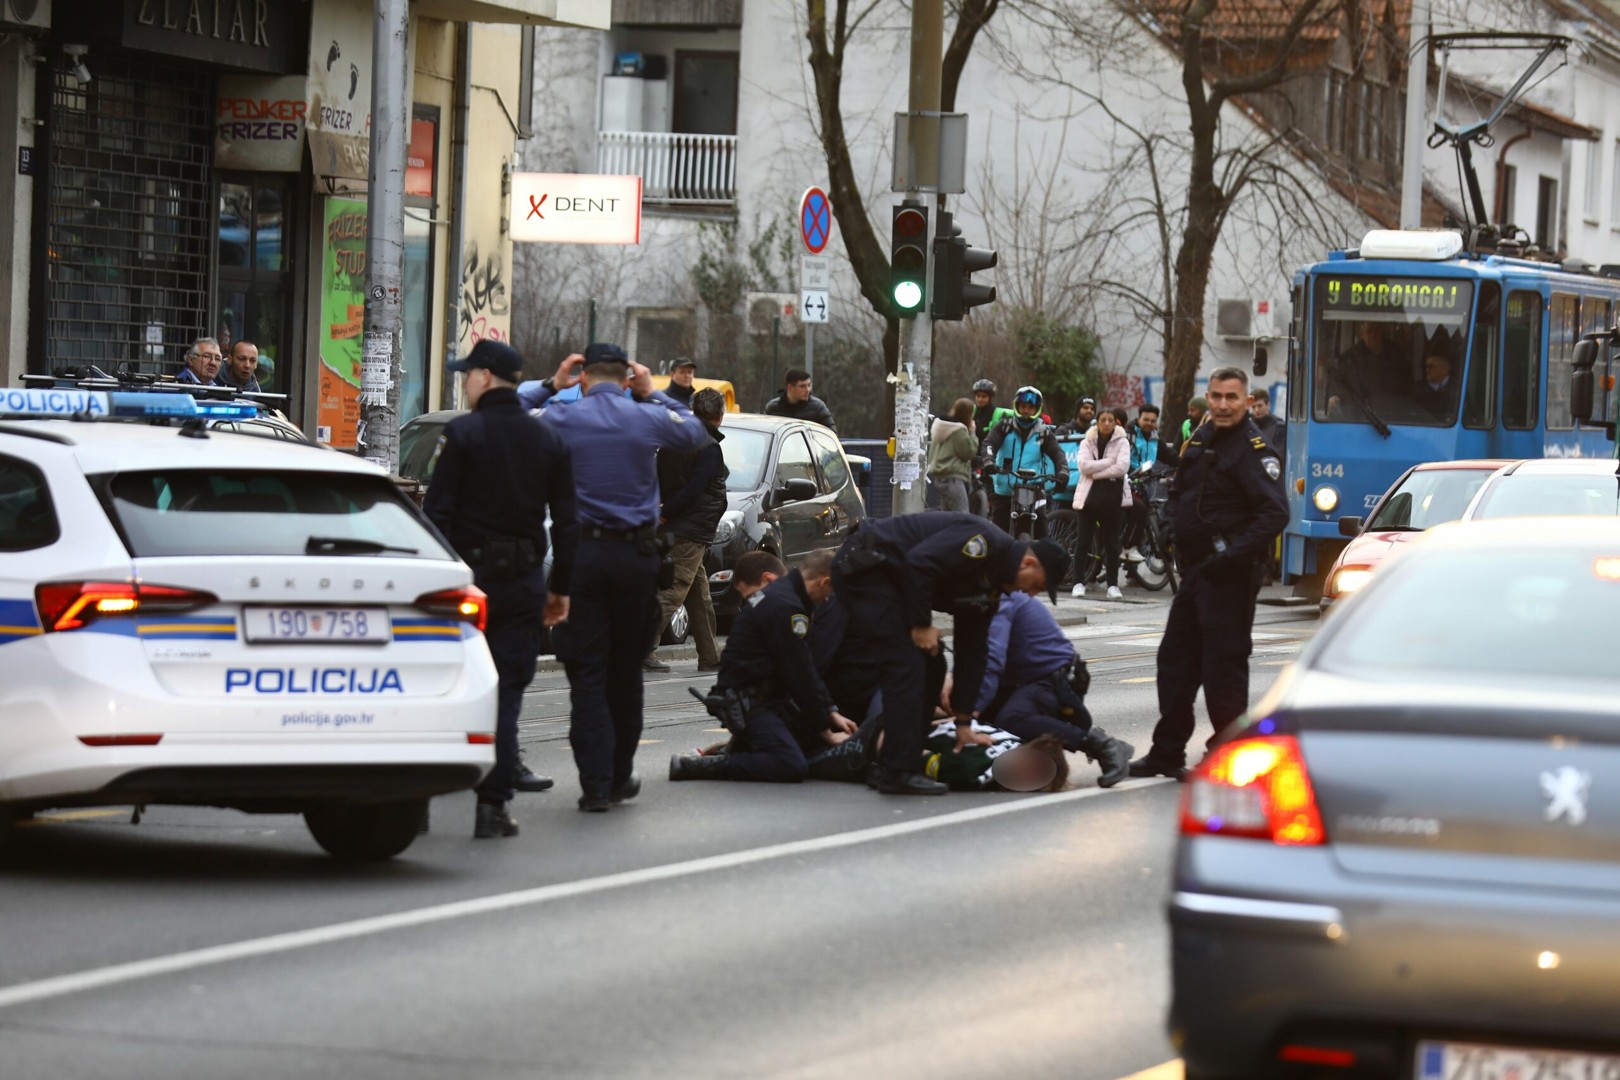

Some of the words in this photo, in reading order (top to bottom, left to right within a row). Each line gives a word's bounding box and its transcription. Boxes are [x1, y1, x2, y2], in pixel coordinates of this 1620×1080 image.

[320, 106, 352, 130] FRIZER
[219, 121, 298, 140] FRIZER
[555, 196, 620, 212] DENT
[1328, 280, 1340, 304] 9
[1350, 282, 1457, 308] BORONGAJ
[1311, 463, 1344, 478] 344
[268, 610, 308, 636] 190
[325, 611, 369, 637] 758
[225, 668, 405, 693] POLICIJA
[281, 712, 375, 727] policija.gov.hr
